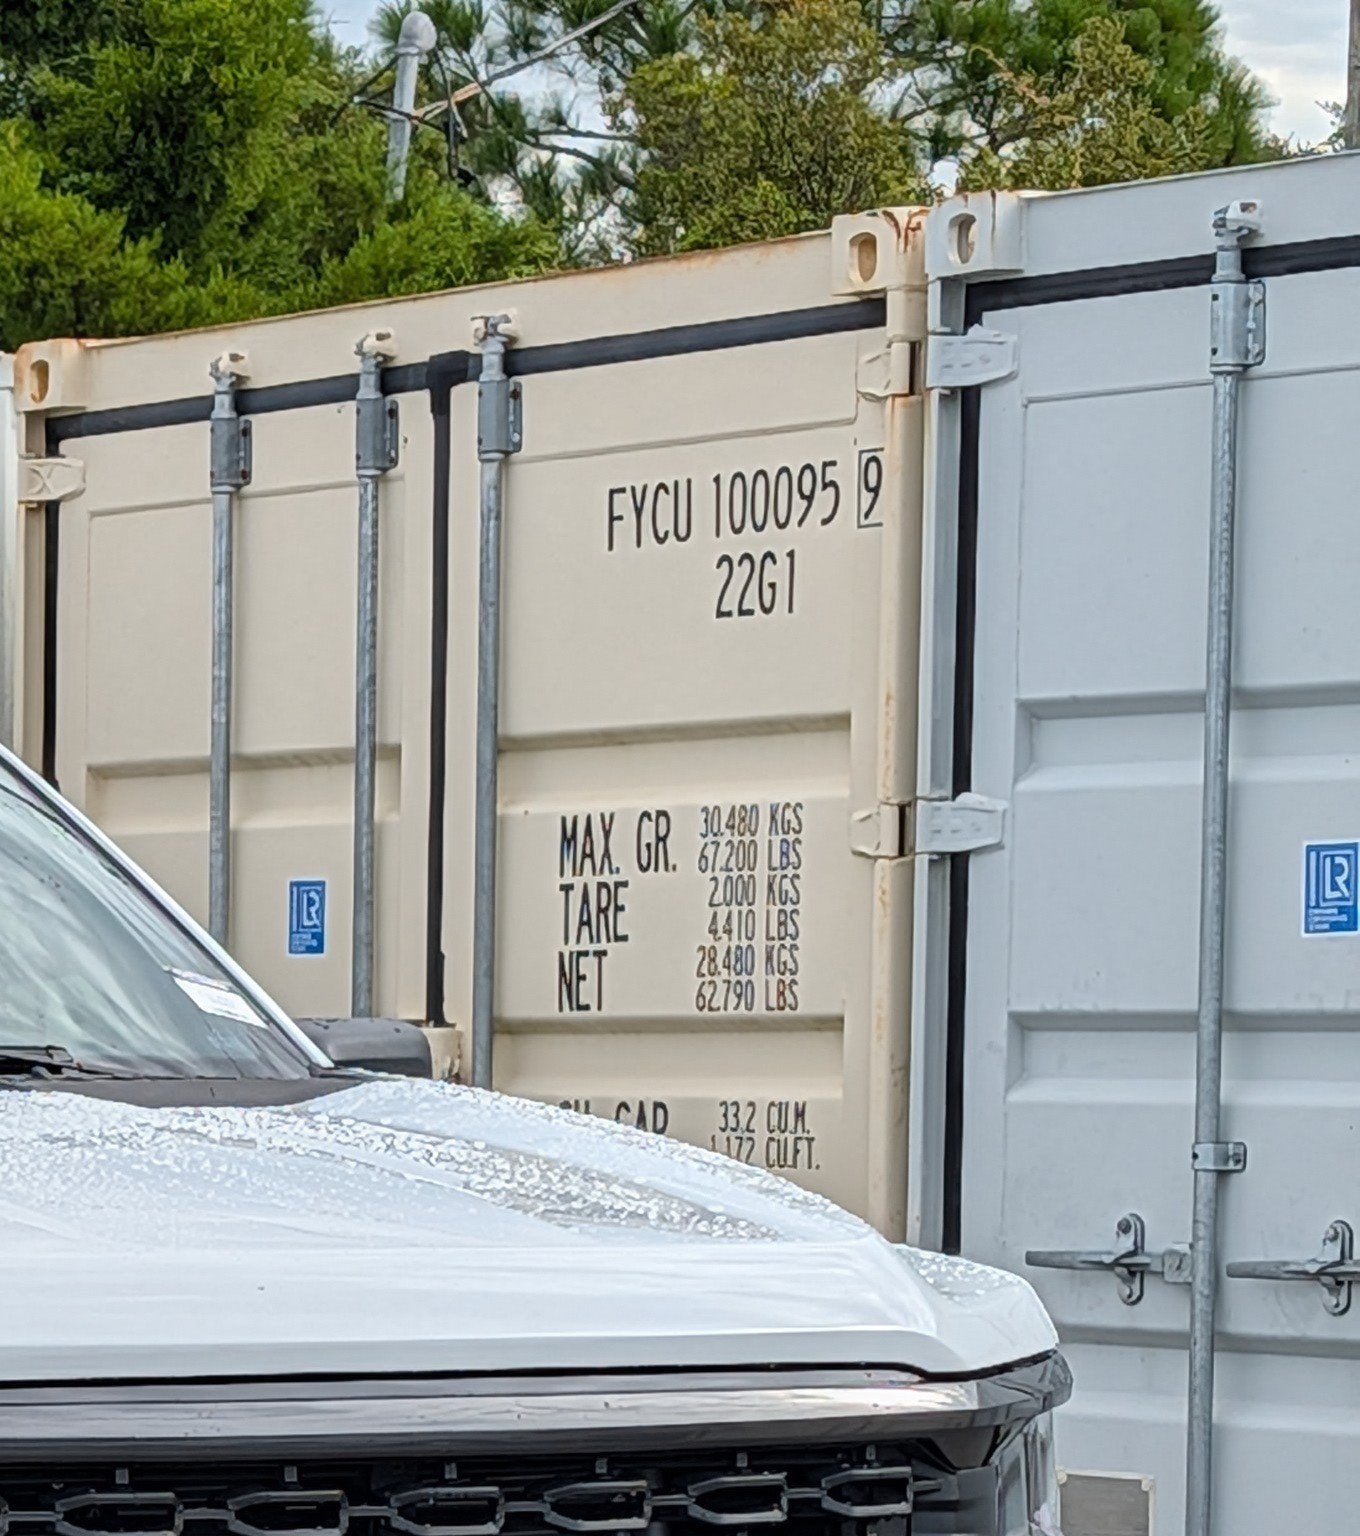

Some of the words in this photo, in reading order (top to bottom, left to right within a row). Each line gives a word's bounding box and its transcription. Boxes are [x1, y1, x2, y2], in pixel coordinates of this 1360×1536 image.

[607, 477, 693, 551] FYCU
[712, 460, 841, 538] 100095
[864, 455, 882, 520] 9
[715, 549, 796, 619] 22G1
[698, 803, 760, 838] 30.480
[768, 801, 804, 837] KGS
[559, 812, 621, 878] MAX.
[637, 809, 677, 874] GR.
[767, 837, 802, 872] LBS
[766, 873, 801, 907] KGS
[559, 880, 629, 945] TARE
[765, 908, 800, 942] LBS
[696, 943, 755, 978] 28.480
[765, 943, 799, 977] KGS
[558, 950, 608, 1013] NET
[765, 978, 799, 1012] LBS
